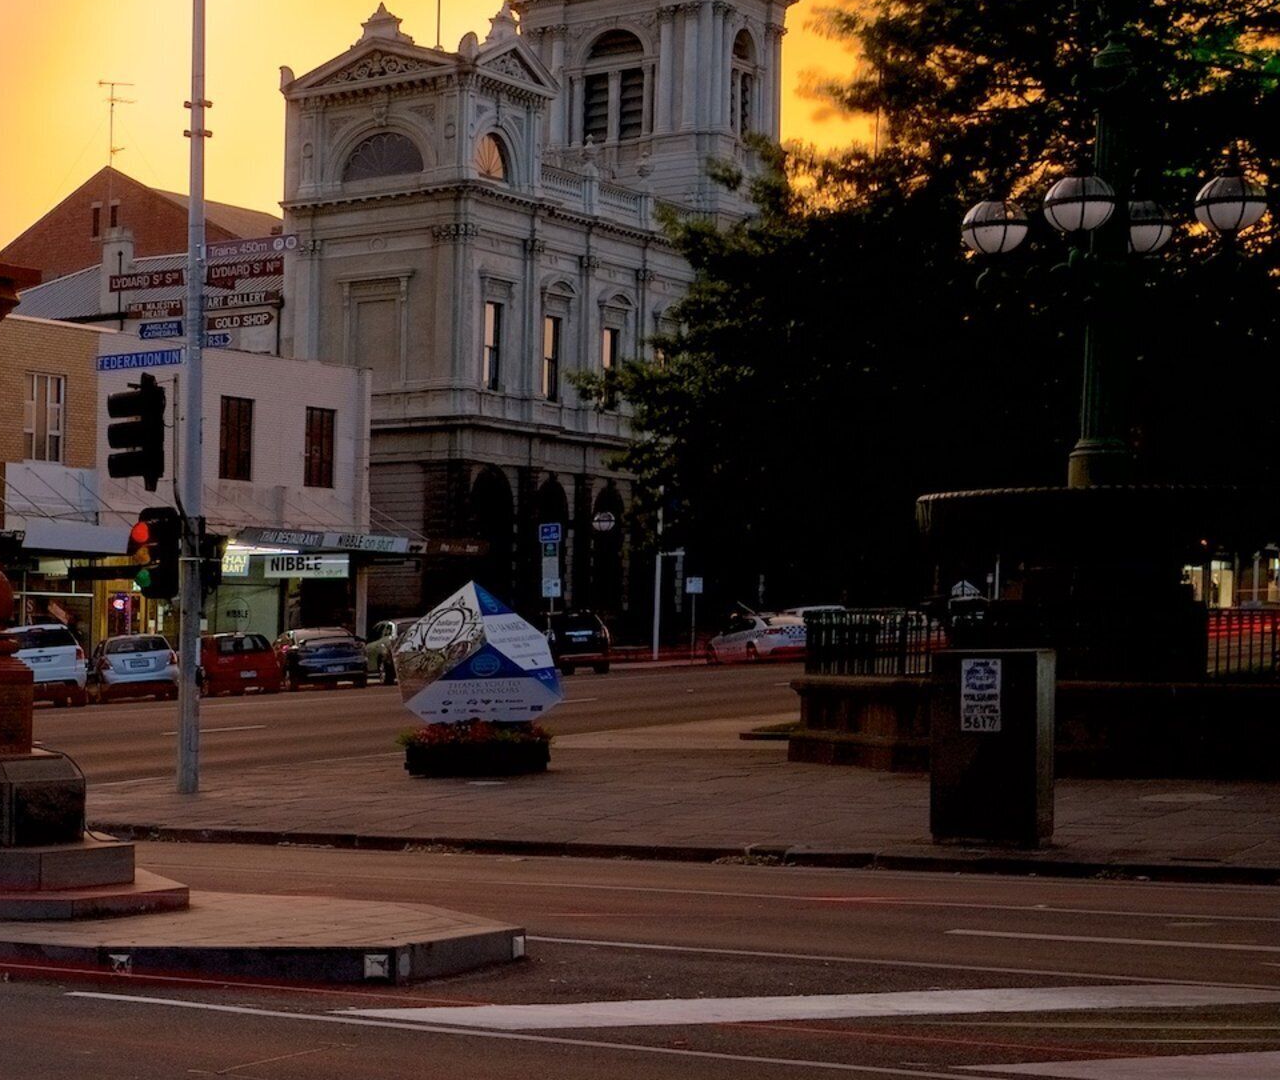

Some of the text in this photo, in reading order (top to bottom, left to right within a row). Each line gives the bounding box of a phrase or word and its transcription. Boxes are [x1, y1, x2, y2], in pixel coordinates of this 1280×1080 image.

[210, 246, 237, 257] Trains
[240, 241, 268, 253] 450m
[211, 264, 251, 278] LYDIARD
[112, 276, 150, 289] LYDIARD
[207, 292, 266, 308] ART GALLERY
[144, 321, 179, 330] ANGLICAN
[215, 313, 269, 329] GOLD SHOP
[143, 328, 180, 338] CATHEDRAL
[207, 334, 227, 347] RSL
[97, 352, 160, 370] FEDERATION
[338, 535, 364, 549] NIBBLE
[270, 556, 323, 572] NIBBLE
[471, 687, 521, 695] SPONSORS
